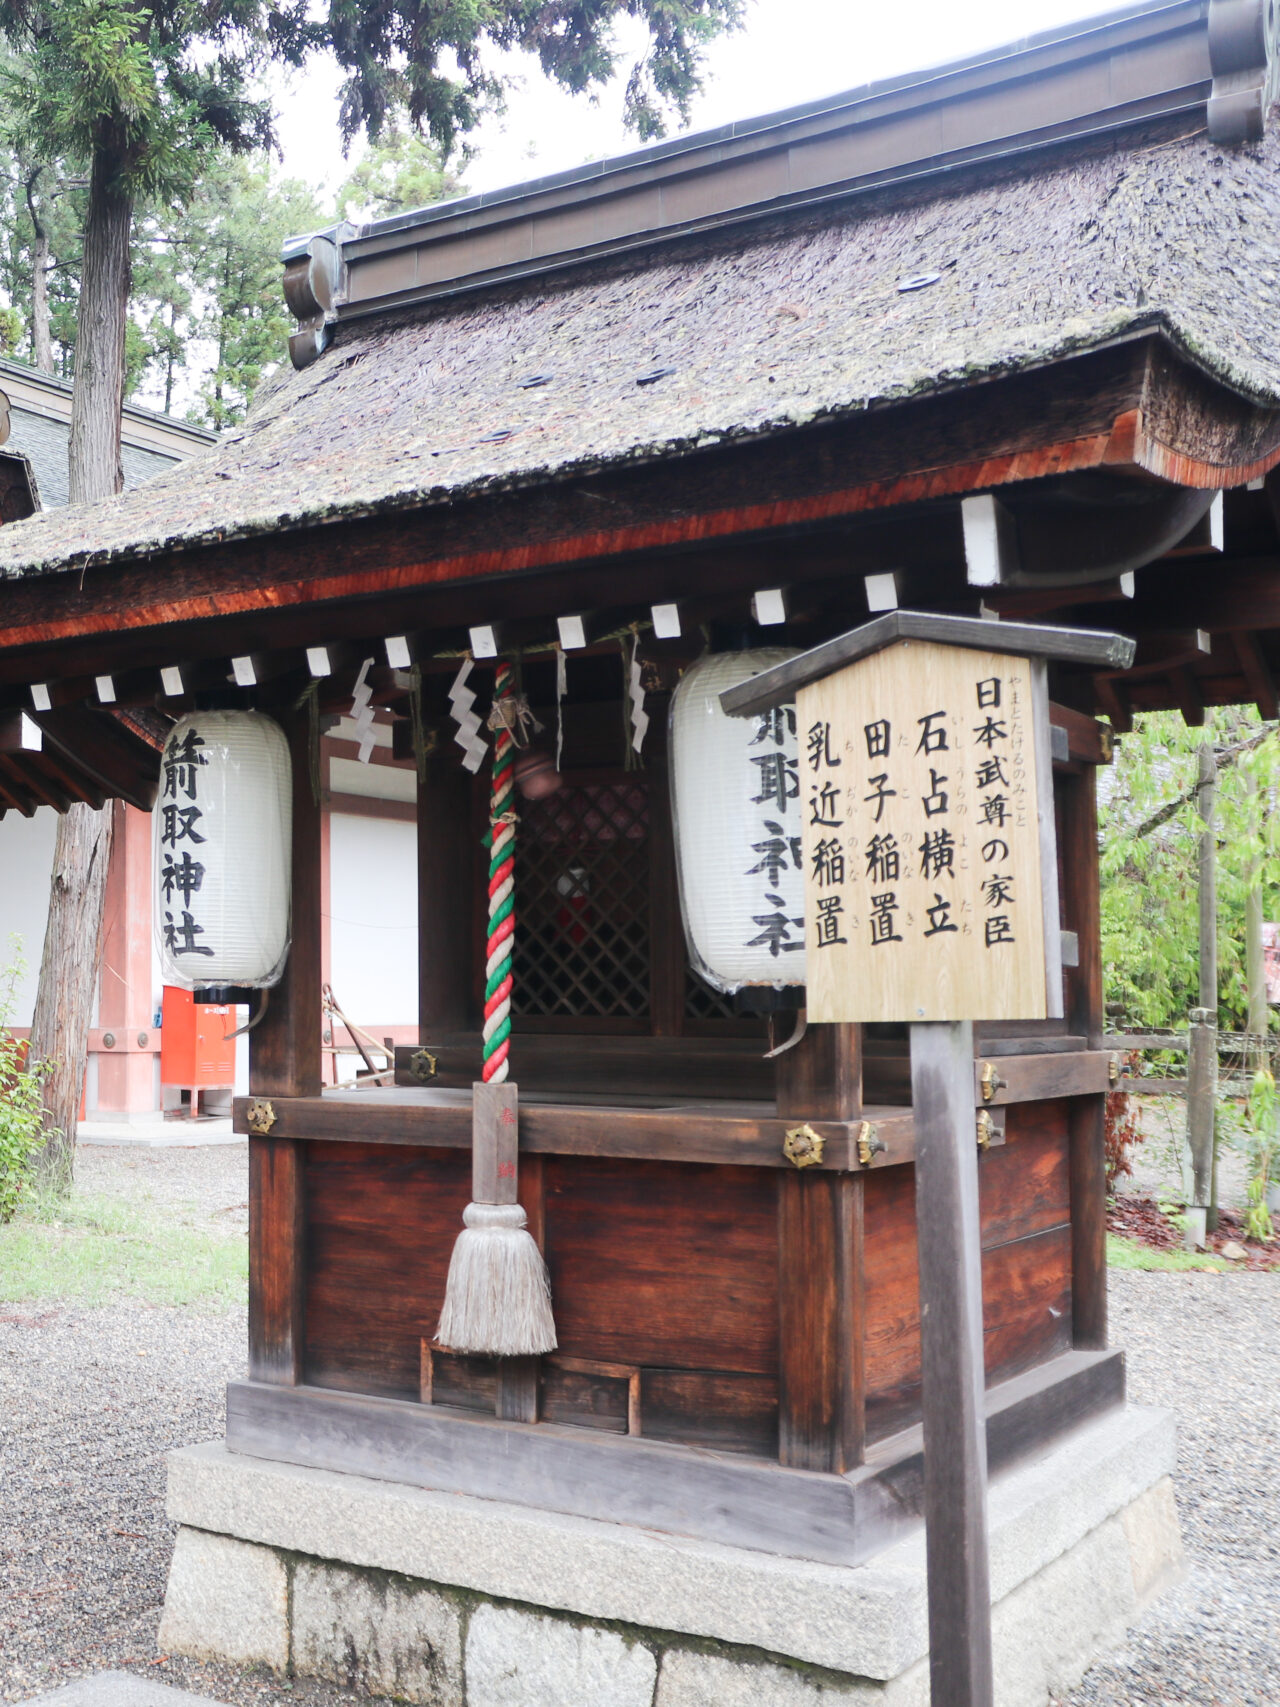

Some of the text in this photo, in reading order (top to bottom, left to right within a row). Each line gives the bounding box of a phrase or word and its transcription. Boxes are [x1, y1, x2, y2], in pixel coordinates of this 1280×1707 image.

[161, 728, 215, 958] 箭取神社
[807, 721, 847, 948] 乳近稲置
[864, 719, 903, 946] 田子稲置
[914, 710, 959, 937] 石占横立
[973, 677, 1015, 948] 日本武尊の家臣
